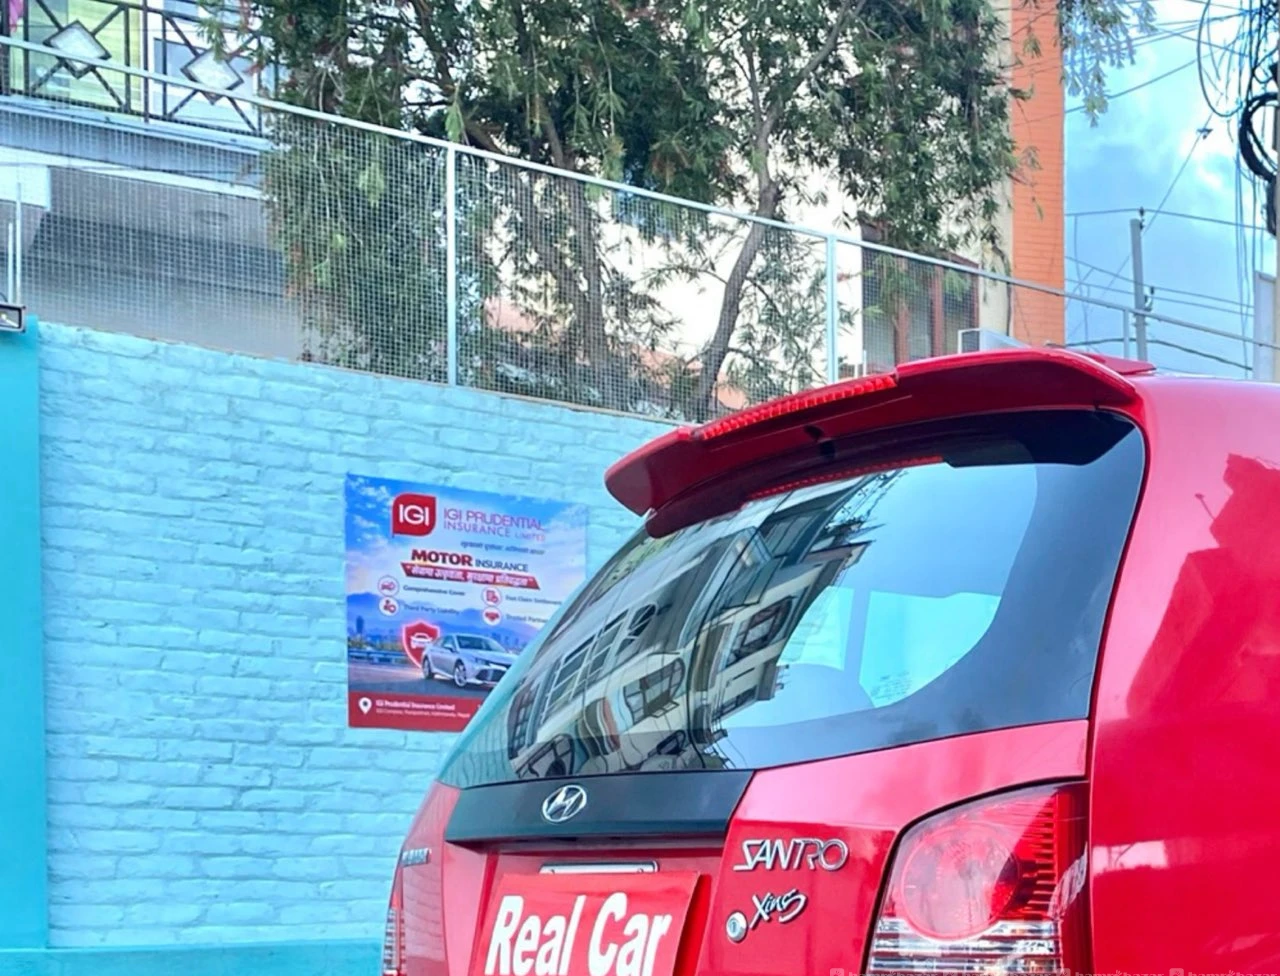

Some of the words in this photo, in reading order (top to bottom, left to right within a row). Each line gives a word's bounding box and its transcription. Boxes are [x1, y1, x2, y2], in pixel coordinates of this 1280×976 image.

[399, 504, 430, 526] IGI
[444, 508, 462, 520] IGI
[466, 510, 545, 531] PRUDENTIAL
[444, 521, 510, 538] INSURANCE
[411, 549, 473, 567] MOTOR
[475, 559, 529, 573] INSURANCE
[733, 838, 848, 871] SANTRO
[484, 895, 587, 976] Real
